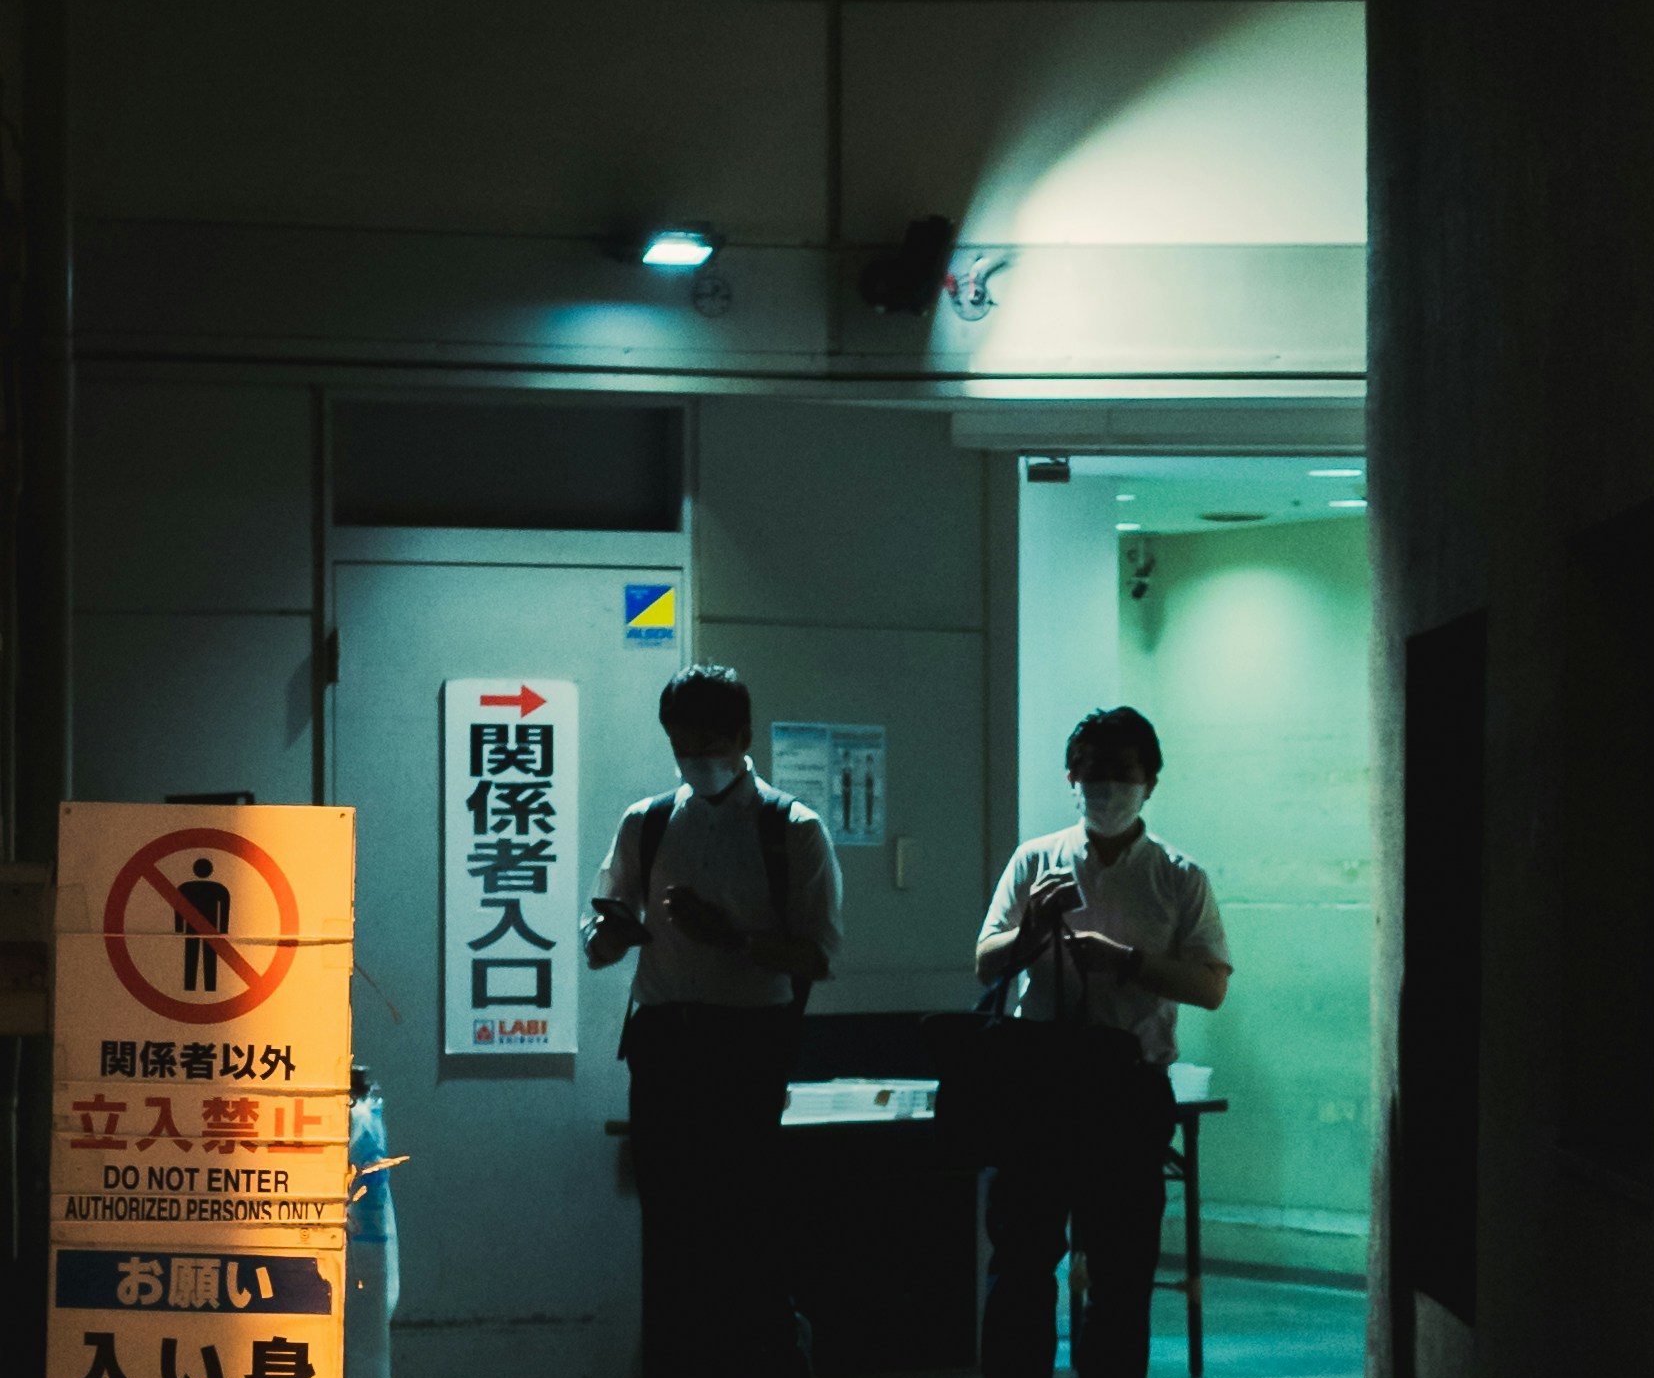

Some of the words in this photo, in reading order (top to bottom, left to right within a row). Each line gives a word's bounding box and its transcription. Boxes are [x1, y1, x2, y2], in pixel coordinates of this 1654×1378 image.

[466, 723, 557, 1009] 関係者入口
[498, 1019, 548, 1035] LABI
[100, 1040, 297, 1081] 関係者以外
[70, 1093, 325, 1154] 立入禁止
[103, 1165, 139, 1190] DO
[148, 1166, 200, 1192] NOT
[207, 1167, 289, 1193] ENTER
[65, 1196, 181, 1221] AUTHORIZED
[186, 1198, 272, 1221] PERSONS
[278, 1200, 326, 1225] ONLY
[115, 1255, 274, 1310] お願い
